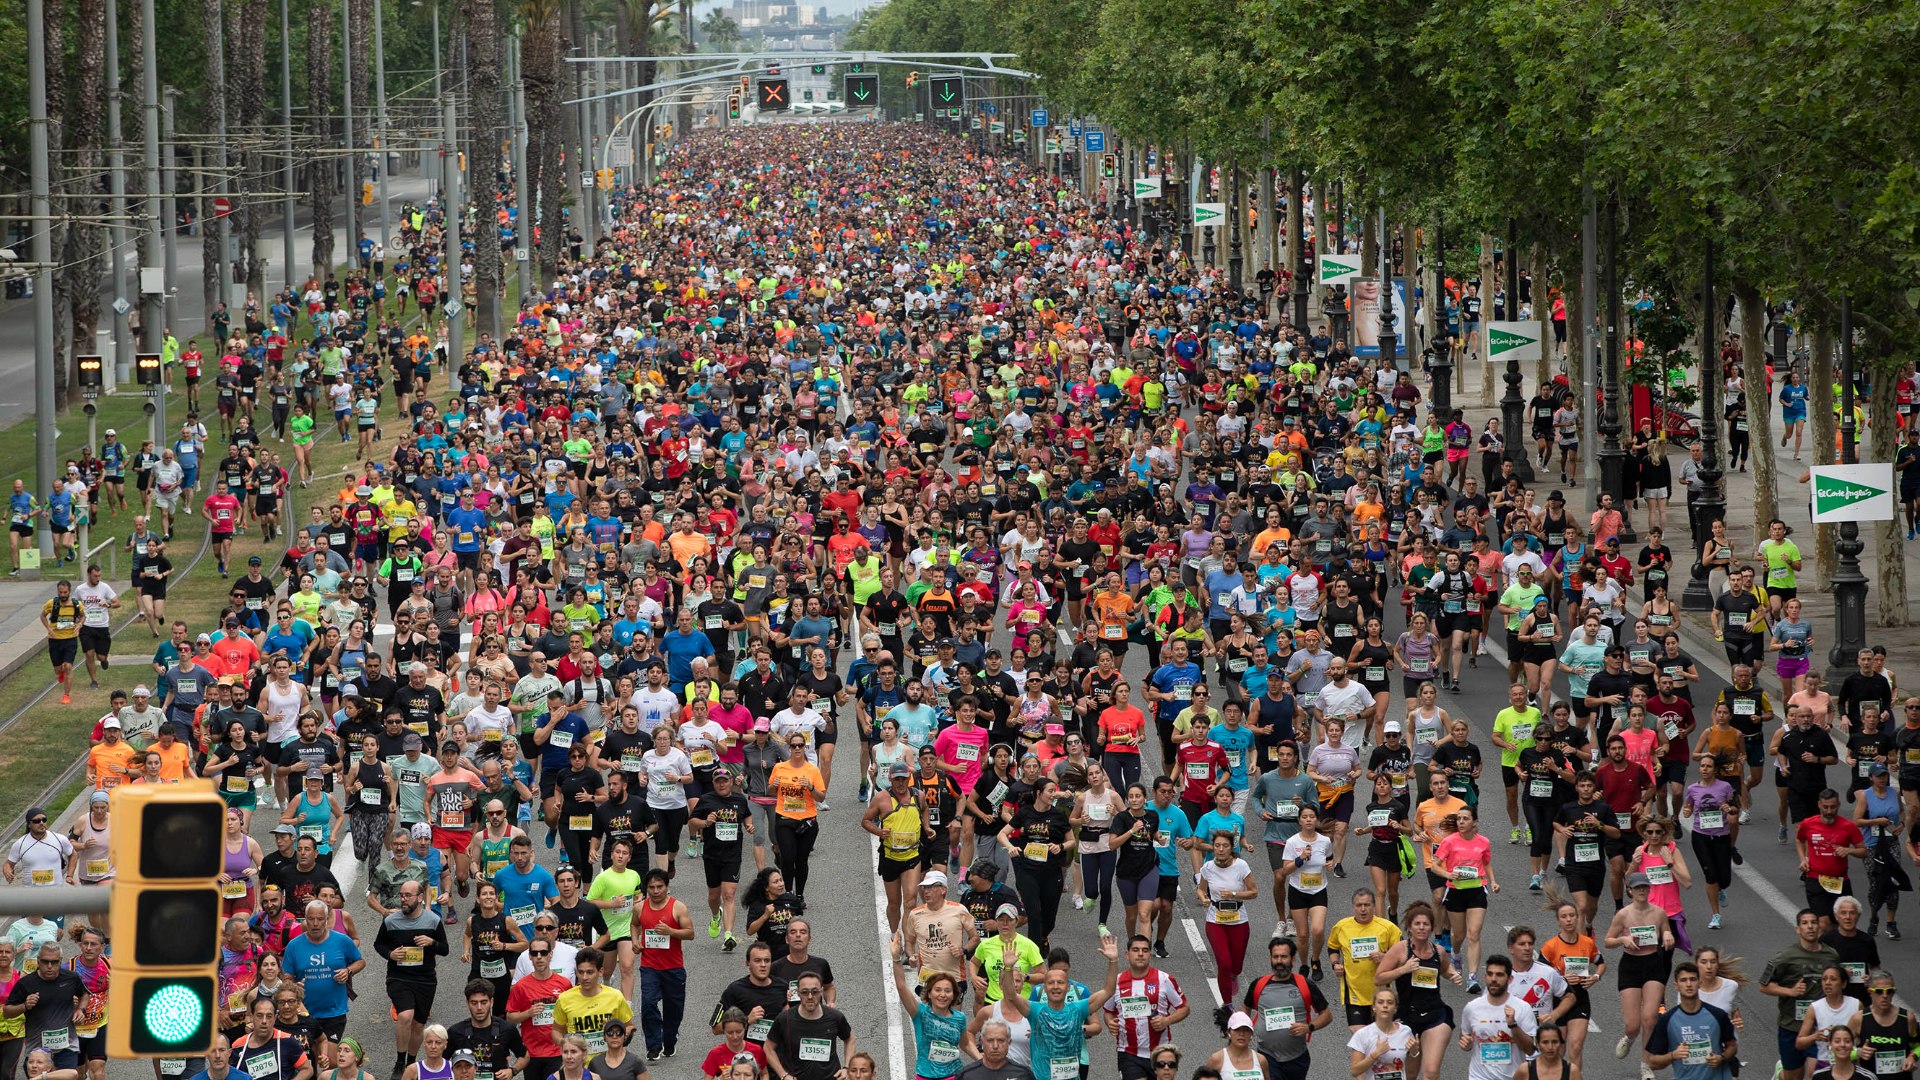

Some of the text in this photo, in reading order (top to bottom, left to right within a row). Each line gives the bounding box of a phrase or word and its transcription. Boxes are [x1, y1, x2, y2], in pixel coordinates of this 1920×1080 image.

[1496, 337, 1509, 345] Corte
[1817, 486, 1872, 500] El Corte Inglés
[441, 793, 463, 803] RUN
[442, 802, 463, 811] VNG
[1649, 872, 1669, 881] 27582
[515, 911, 534, 921] 22106
[1354, 945, 1375, 953] 27318
[1125, 1003, 1147, 1012] 26657
[1269, 1015, 1291, 1025] 26655
[1681, 1026, 1695, 1035] EL
[805, 1046, 826, 1055] 13155
[933, 1049, 957, 1058] 29875
[1485, 1050, 1506, 1059] 2640
[252, 1061, 274, 1073] 12876
